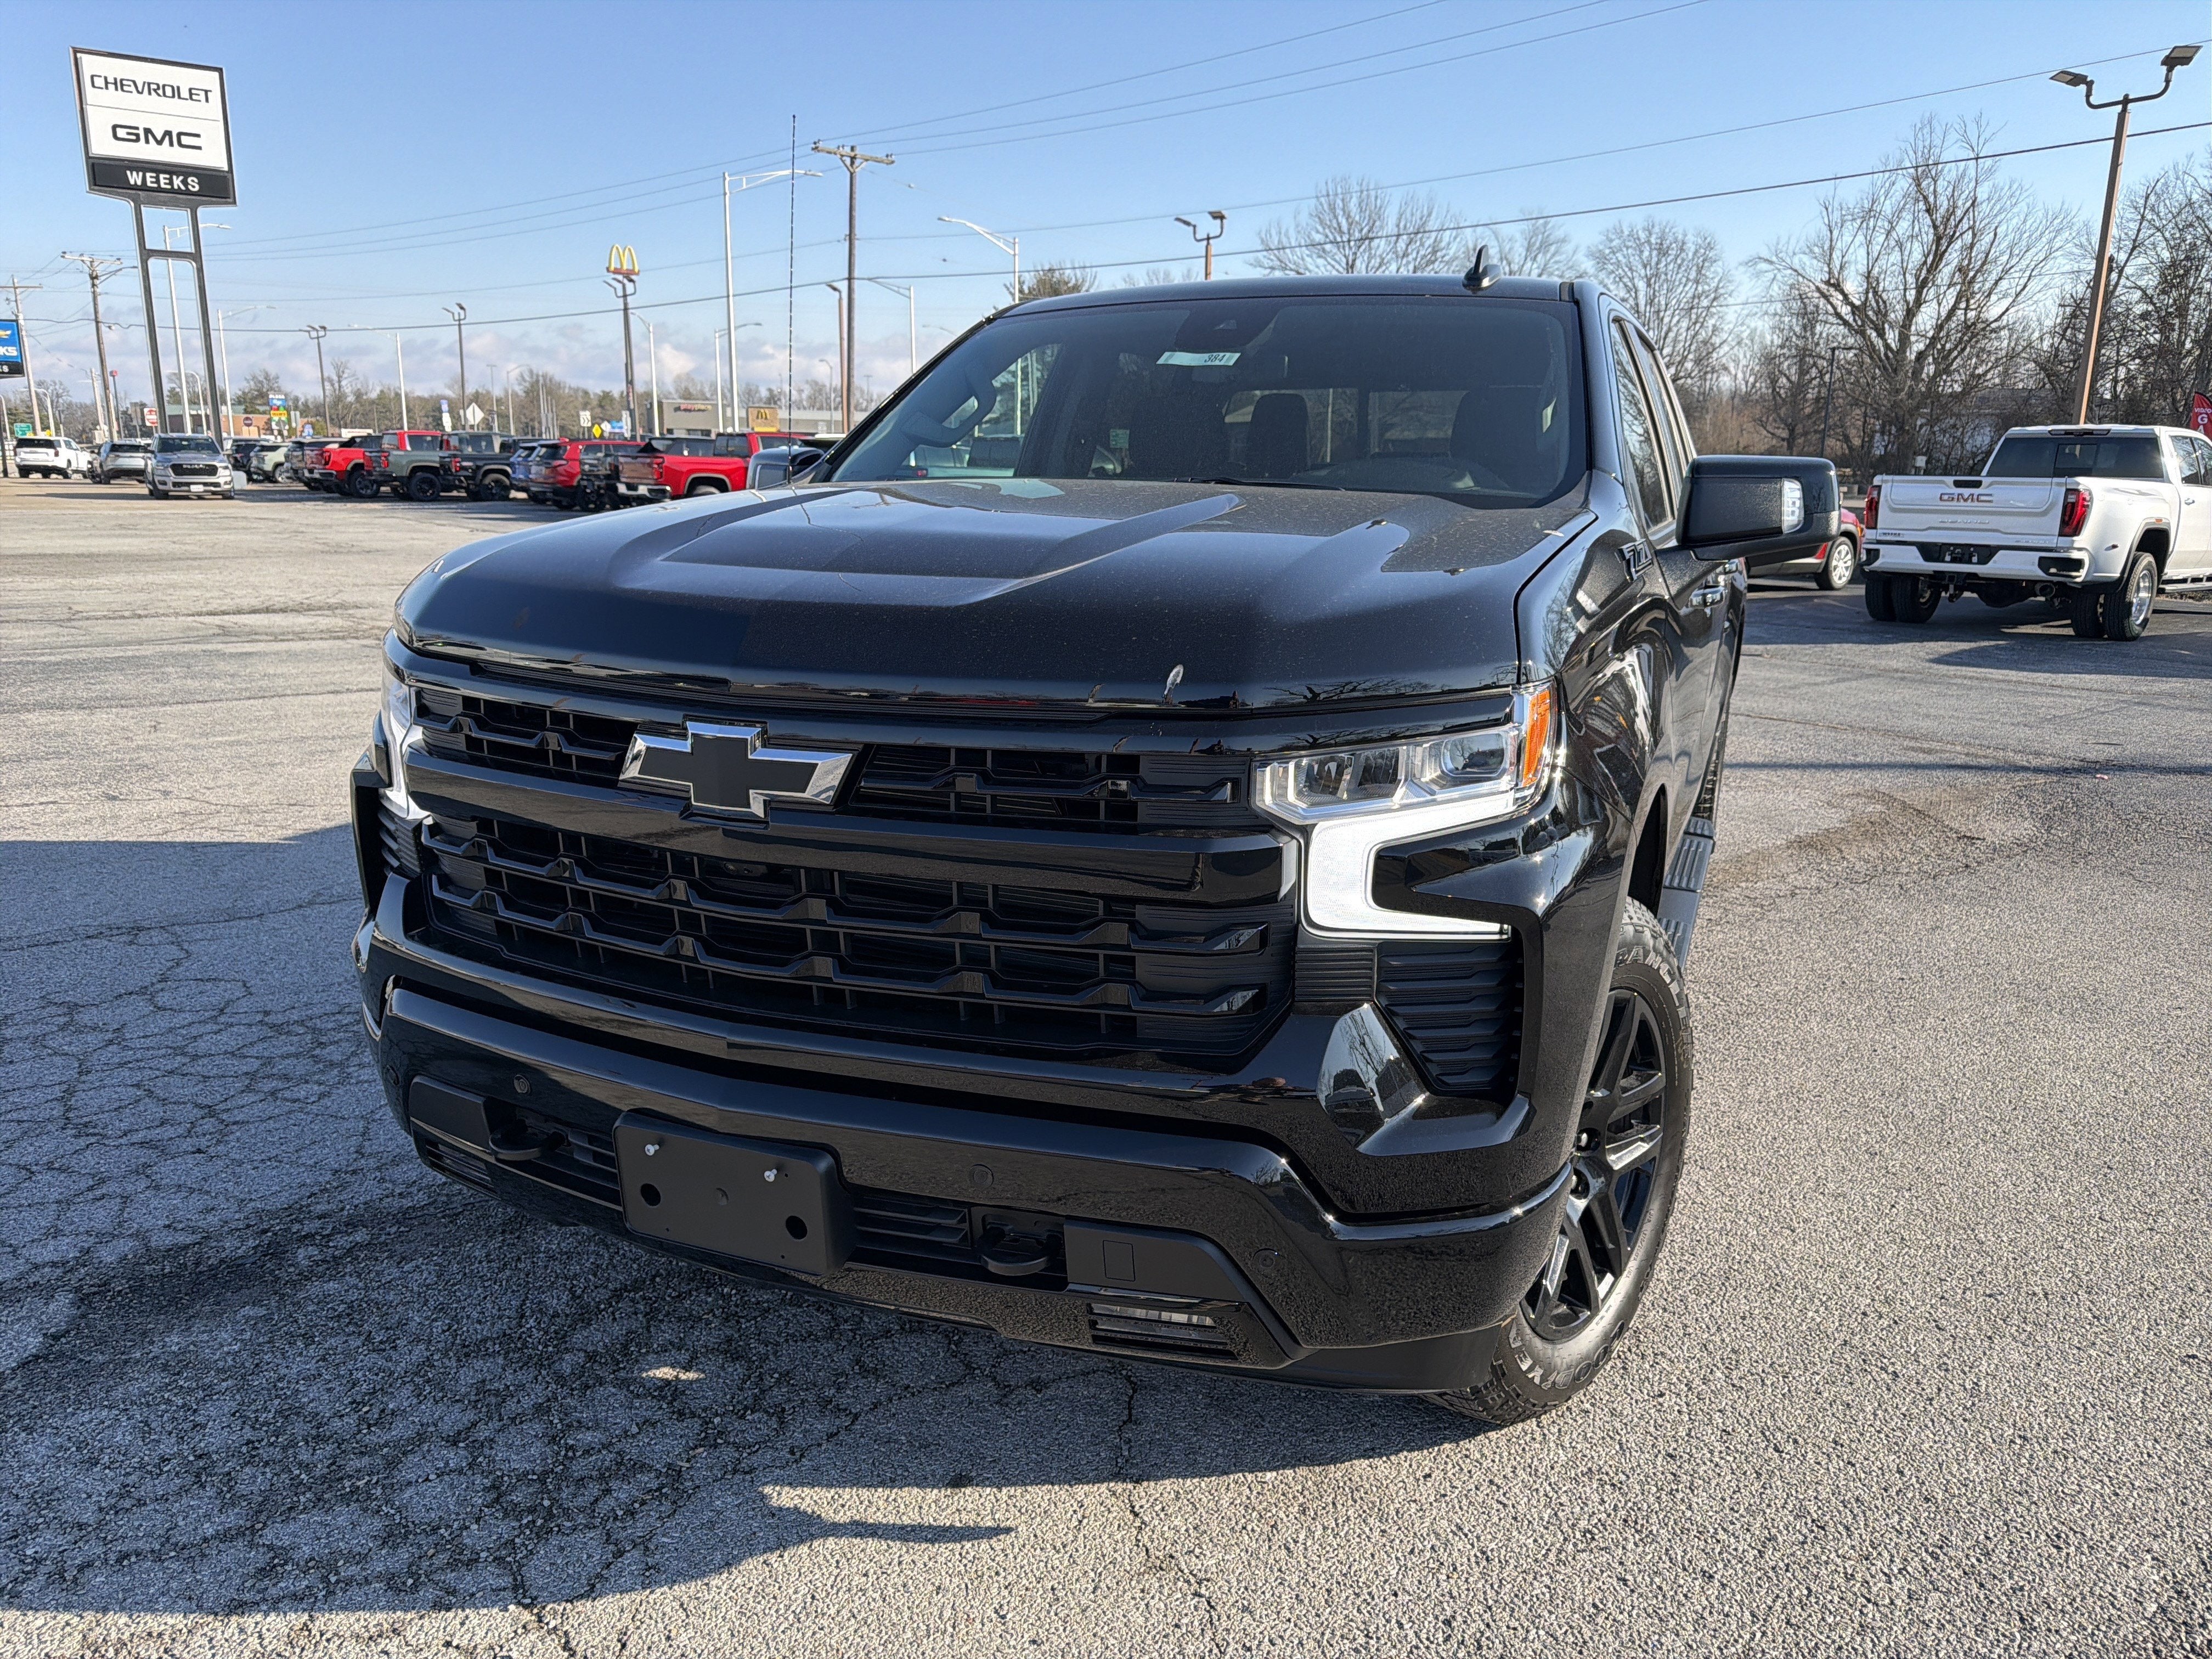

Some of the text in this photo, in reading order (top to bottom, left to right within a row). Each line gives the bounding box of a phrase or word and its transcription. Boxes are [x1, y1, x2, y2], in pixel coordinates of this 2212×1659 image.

[90, 74, 212, 103] CHEVROLET
[111, 124, 202, 150] GMC
[126, 170, 200, 191] WEEKS
[1939, 493, 1994, 504] GMC
[1509, 1319, 1625, 1390] GOODYEA
